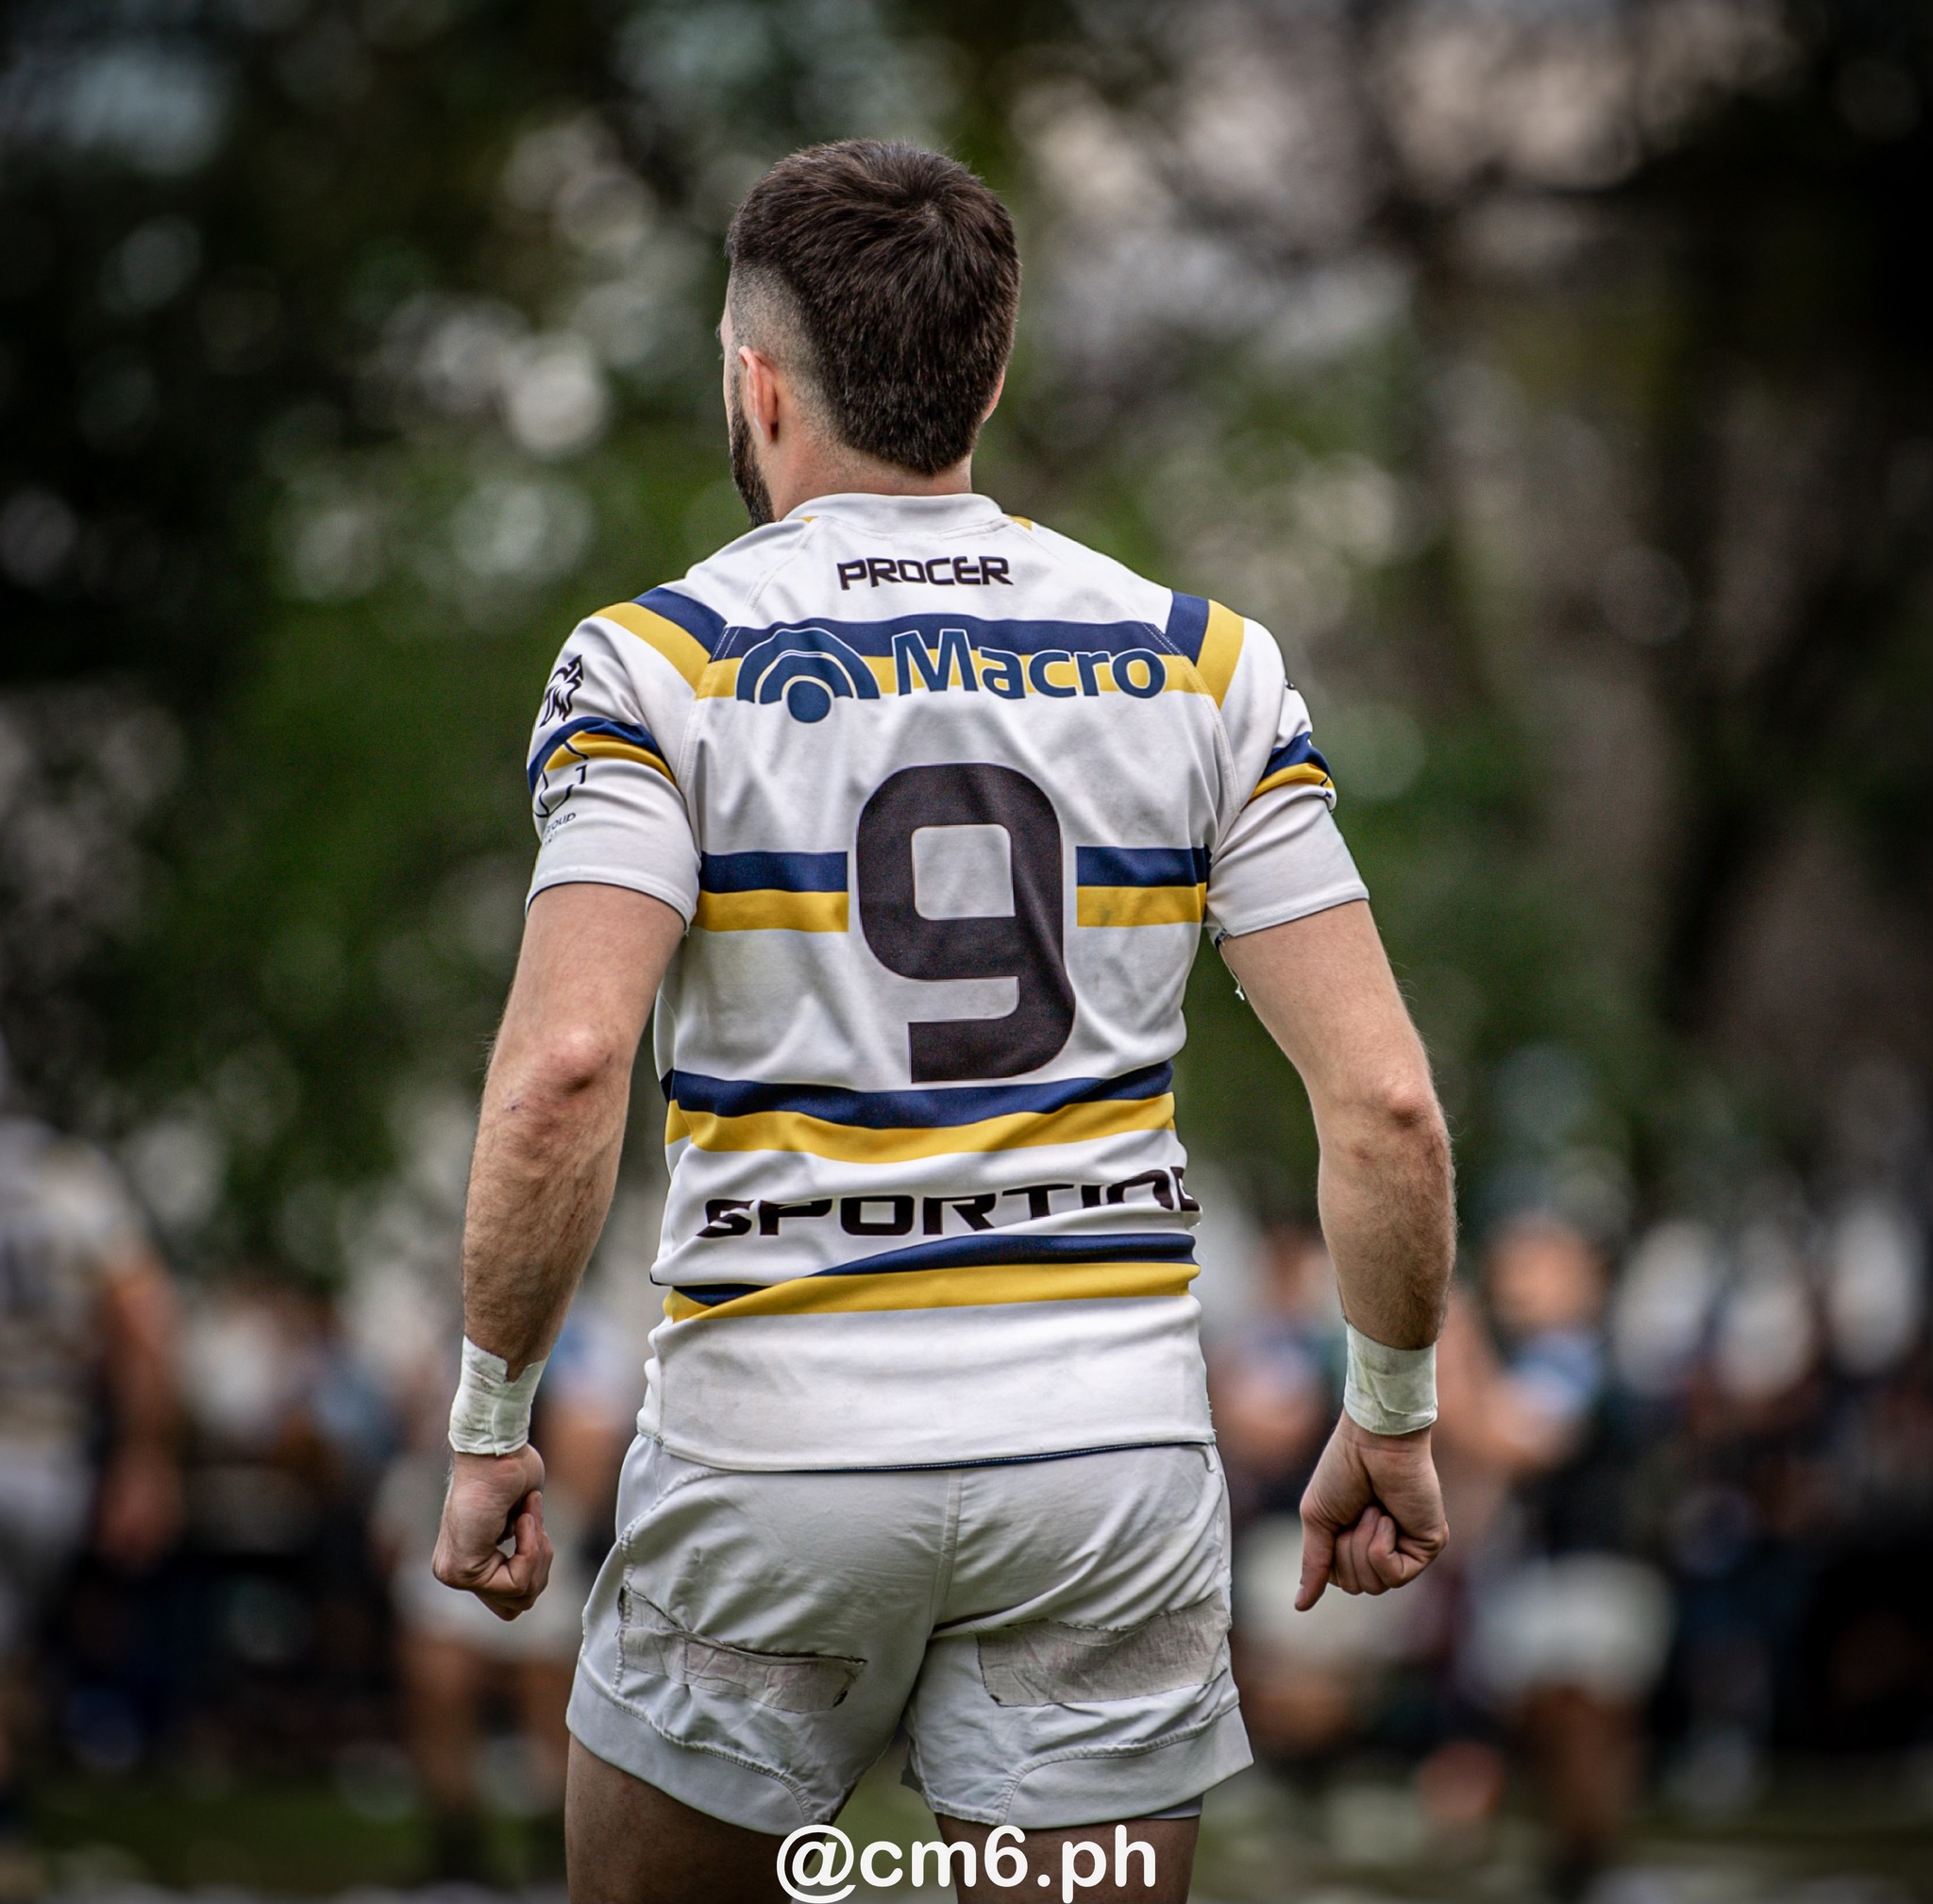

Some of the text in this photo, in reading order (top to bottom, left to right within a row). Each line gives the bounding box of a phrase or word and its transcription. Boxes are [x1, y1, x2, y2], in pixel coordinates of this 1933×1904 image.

[836, 555, 1014, 591] PROCER
[891, 628, 1167, 699] Macro
[855, 762, 1076, 1084] 9
